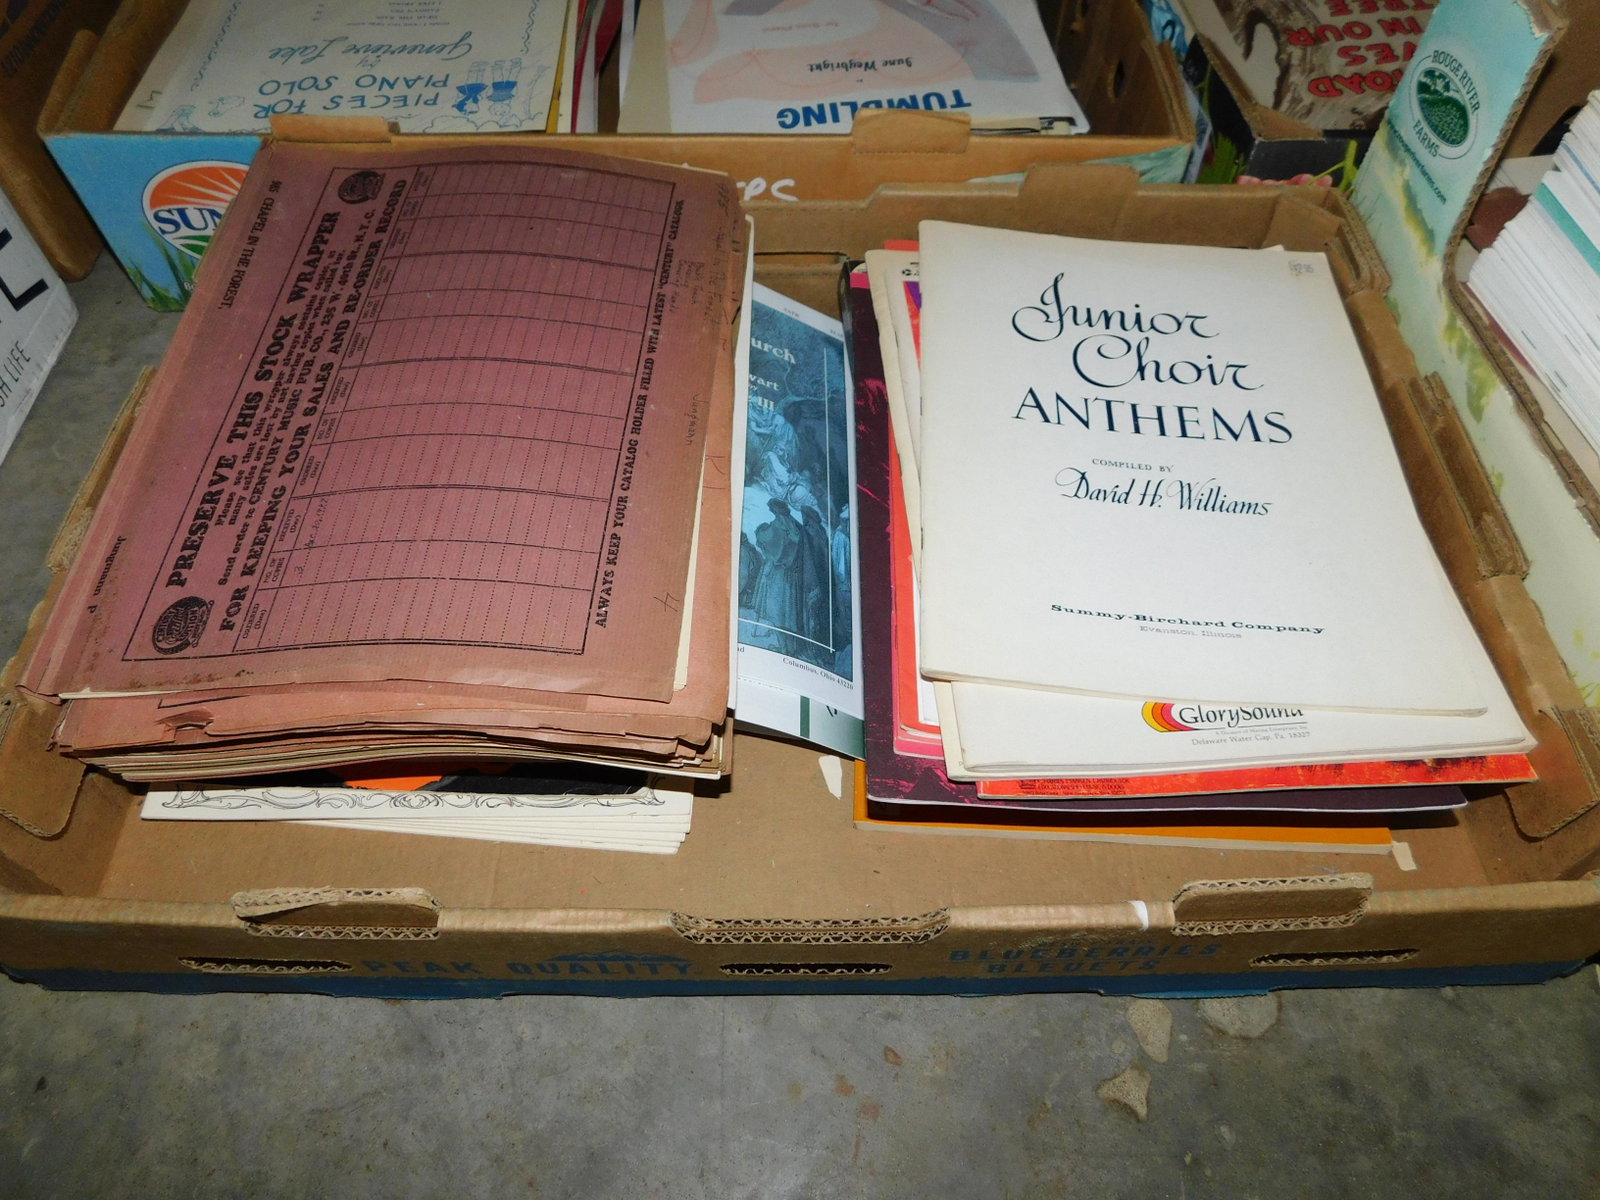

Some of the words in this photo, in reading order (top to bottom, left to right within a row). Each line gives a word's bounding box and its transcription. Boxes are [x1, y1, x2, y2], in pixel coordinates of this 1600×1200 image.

[1284, 21, 1372, 47] OUR
[1377, 16, 1424, 37] IN
[269, 36, 348, 63] Lake
[342, 31, 474, 61] Genevieve
[808, 59, 878, 73] Weybright
[882, 57, 912, 67] June
[258, 75, 338, 95] SOLO
[356, 73, 449, 89] PIANO
[1432, 50, 1462, 77] ROUGE
[1460, 70, 1480, 114] RIVER
[253, 102, 306, 118] FOR
[323, 92, 440, 110] PIECES
[1413, 120, 1439, 158] FARMS
[251, 197, 275, 233] CHAPEL
[246, 234, 260, 246] IN
[236, 247, 255, 268] THE
[217, 268, 246, 310] FOREST,
[321, 307, 338, 326] 235
[652, 292, 668, 326] LATEST
[1012, 272, 1220, 342] Junior
[648, 329, 661, 354] WITH
[751, 338, 796, 364] urch
[3, 340, 31, 383] LIFE
[297, 355, 318, 384] PUB.
[640, 358, 655, 391] FILLED
[1072, 334, 1264, 391] Choir
[165, 455, 240, 587] PRESERVE
[227, 391, 266, 443] THIS
[253, 314, 299, 382] STOCK
[287, 211, 341, 304] WRAPPER
[216, 492, 239, 526] Please
[233, 470, 248, 485] see
[242, 442, 259, 464] that
[253, 418, 269, 436] this
[263, 370, 288, 413] wrapper
[282, 335, 303, 366] always
[297, 295, 319, 330] contains
[219, 586, 251, 632] FOR
[240, 485, 289, 576] KEEPING
[279, 424, 313, 477] YOUR
[303, 362, 336, 417] SALES
[327, 320, 352, 355] AND
[343, 240, 384, 314] RE-ORDER
[375, 180, 408, 234] RECORD
[227, 497, 248, 525] many
[241, 466, 260, 490] sales
[253, 446, 268, 461] are
[261, 424, 277, 441] lost
[270, 408, 283, 419] by
[277, 388, 292, 403] not
[285, 353, 306, 383] having
[299, 323, 318, 349] copies
[312, 296, 329, 318] when
[322, 268, 340, 292] called
[278, 389, 305, 431] MUSIC
[631, 395, 649, 435] HOLDER
[1011, 387, 1293, 444] ANTHEMS
[248, 437, 286, 505] CENTURY
[620, 439, 640, 492] CATALOG
[1092, 458, 1152, 471] COMPILED
[1159, 464, 1174, 473] BY
[1055, 467, 1136, 505] David
[1139, 479, 1166, 508] H.
[1165, 477, 1274, 516] Williams
[245, 508, 257, 518] to
[613, 496, 630, 528] YOUR
[231, 522, 251, 553] order
[606, 533, 623, 566] KEEP
[93, 536, 126, 596] Jungmann
[218, 558, 237, 585] Send
[594, 570, 617, 628] ALWAYS
[1051, 604, 1226, 628] Summy-Birchard
[1231, 621, 1325, 635] Company
[1201, 629, 1242, 639] Illinois
[1191, 738, 1227, 746] Delaware
[1229, 735, 1252, 743] Water
[360, 960, 486, 975] PEAK
[506, 961, 694, 977] QUALITY
[949, 943, 1224, 963] BLUEBERRIES
[985, 959, 1161, 975] BLEUETS
